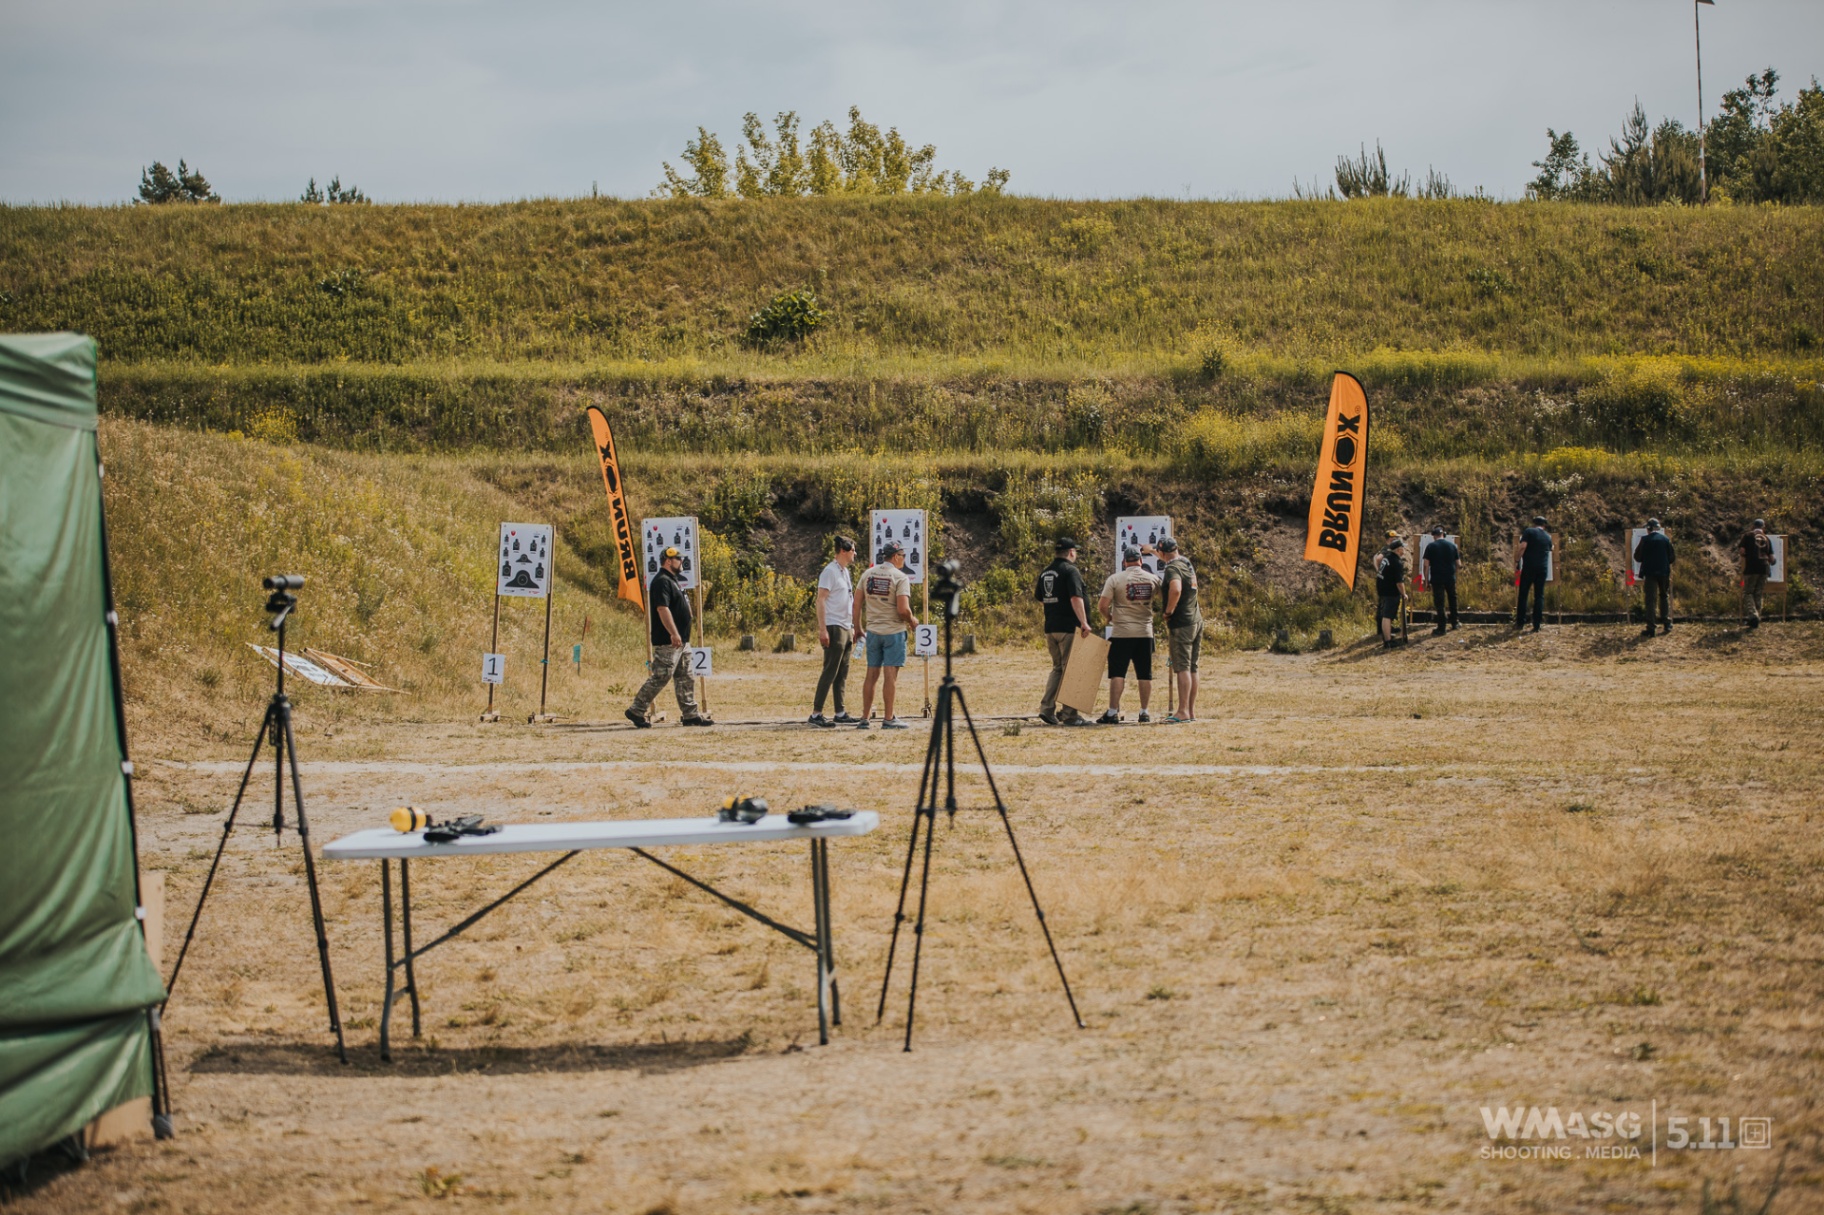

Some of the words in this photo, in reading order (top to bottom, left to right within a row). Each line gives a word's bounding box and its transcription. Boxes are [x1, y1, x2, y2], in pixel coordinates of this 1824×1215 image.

[920, 628, 932, 647] 3
[487, 657, 499, 676] 1
[695, 650, 707, 670] 2
